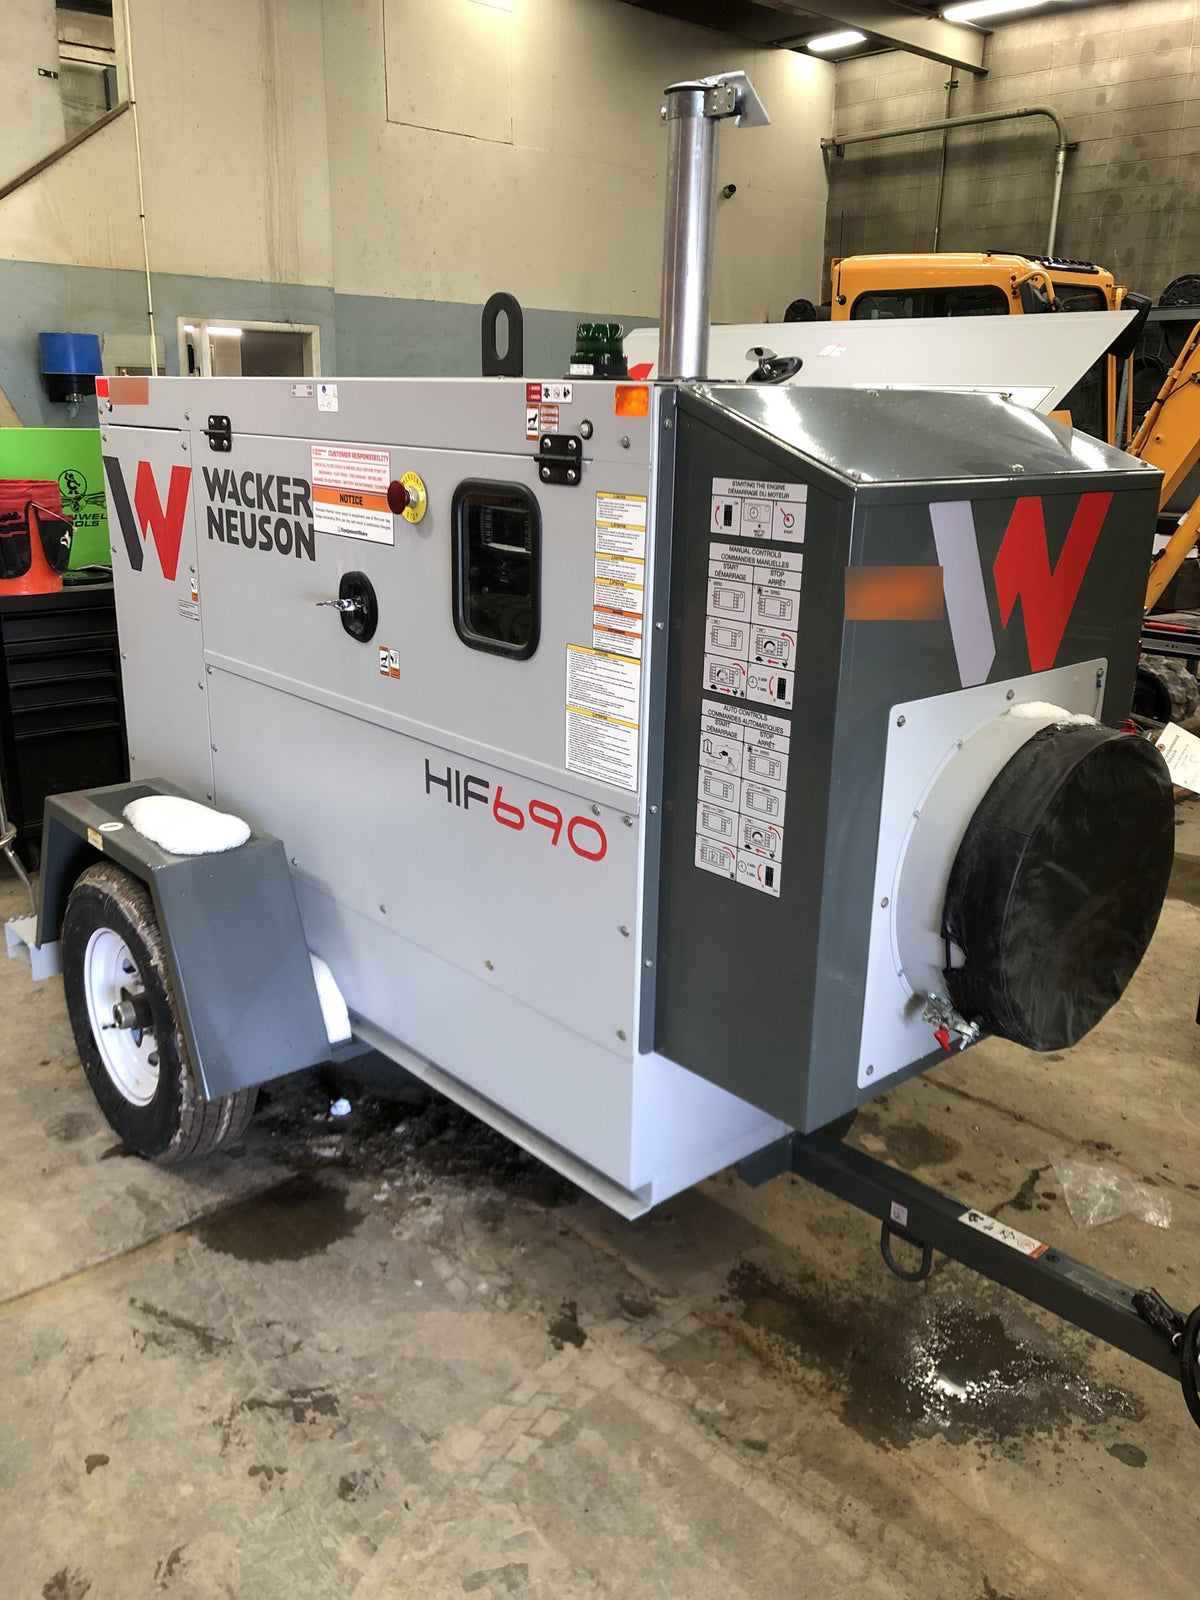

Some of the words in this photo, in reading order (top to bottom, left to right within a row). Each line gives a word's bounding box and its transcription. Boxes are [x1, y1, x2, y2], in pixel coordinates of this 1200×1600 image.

[328, 450, 352, 459] CUSTOMER
[352, 452, 389, 463] RESPONSIBILITY
[732, 480, 756, 489] STARTING
[756, 482, 766, 490] THE
[766, 483, 786, 491] ENGINE
[202, 466, 314, 519] WACKER
[728, 487, 759, 497] DÉMARRAGE
[759, 490, 767, 498] DU
[767, 491, 790, 499] MOTEUR
[339, 493, 363, 506] NOTICE
[206, 506, 316, 562] NEUSON
[729, 545, 751, 555] MANUAL
[751, 548, 782, 559] CONTROLS
[721, 553, 755, 564] COMMANDES
[756, 558, 790, 569] MANUELLES
[770, 569, 785, 578] STOP
[768, 578, 786, 587] ARRÊT
[723, 704, 738, 714] AUTO
[739, 708, 768, 722] CONTROLS
[707, 708, 742, 722] COMMANDES
[742, 718, 784, 734] AUTOMATIQUES
[714, 719, 730, 728] START
[760, 731, 774, 739] STOP
[424, 757, 608, 862] HIF690
